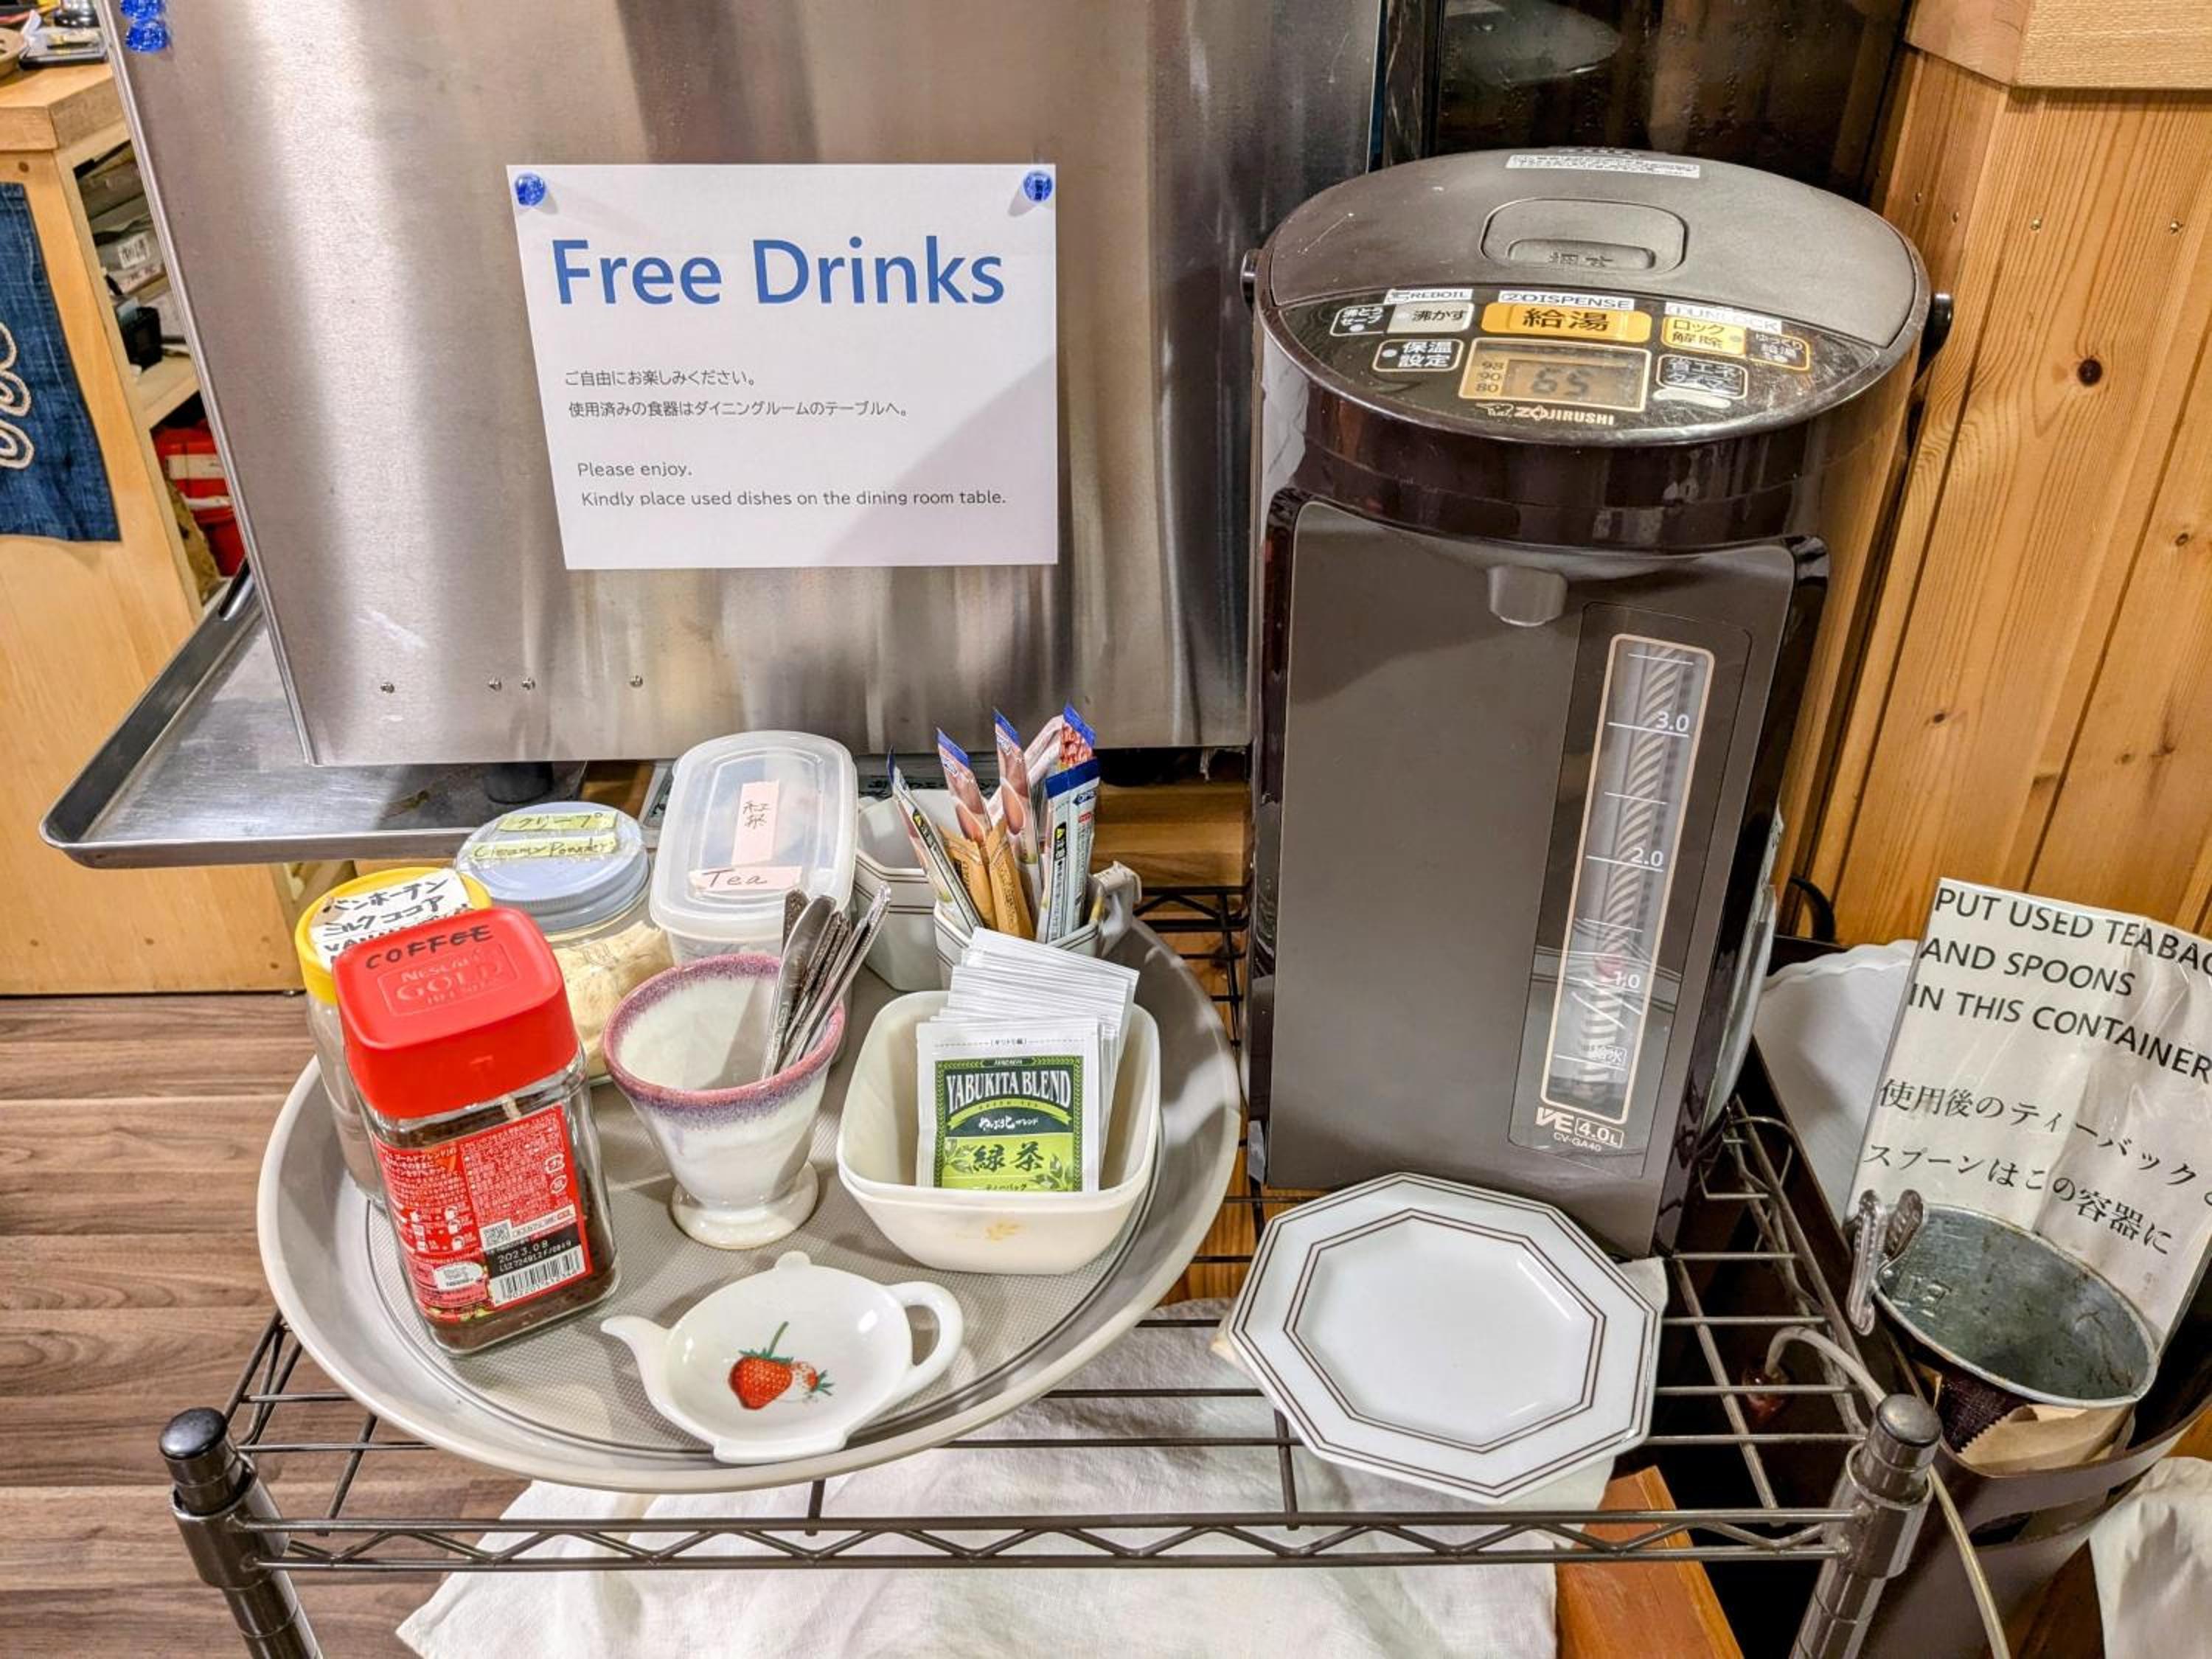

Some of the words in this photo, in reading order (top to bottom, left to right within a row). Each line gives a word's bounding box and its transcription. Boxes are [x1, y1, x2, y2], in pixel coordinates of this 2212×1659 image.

[551, 238, 722, 305] Free
[751, 234, 1006, 305] Drinks
[1411, 310, 1467, 321] 沸かす
[1523, 308, 1610, 332] 給湯
[1673, 319, 1725, 335] ロック
[1402, 340, 1453, 353] 保温
[1398, 355, 1451, 368] 設定
[565, 369, 755, 387] ご自由にお楽しみください。
[568, 400, 907, 419] 使用済みの食器はダイニングルームのテーブルへ。
[1514, 405, 1615, 425] ZOJIRUSHI
[577, 462, 635, 477] Please
[640, 463, 692, 479] enjoy.
[582, 491, 634, 507] Kindly
[640, 491, 686, 507] place
[691, 491, 731, 506] used
[737, 491, 792, 506] dishes
[797, 494, 818, 506] on
[823, 491, 850, 506] the
[856, 490, 908, 507] dining
[913, 493, 954, 505] room
[959, 490, 1006, 505] table.
[1655, 711, 1689, 732] 3.0
[1630, 847, 1663, 866] 2.0
[702, 868, 768, 888] Tea
[324, 894, 445, 936] ミルクココア
[1935, 888, 2001, 921] PUT
[2009, 901, 2094, 939] USED
[365, 925, 493, 970] COFFEE
[1920, 937, 1996, 971] AND
[2003, 952, 2136, 997] SPOONS
[1614, 971, 1641, 989] 1.0
[1907, 983, 1944, 1012] IN
[1956, 992, 2024, 1023] THIS
[946, 1071, 1020, 1114] YABUKITA
[1021, 1070, 1071, 1108] BLEND
[973, 1140, 1044, 1172] 緑茶
[1864, 1143, 2174, 1255] スプーンはこの容器に
